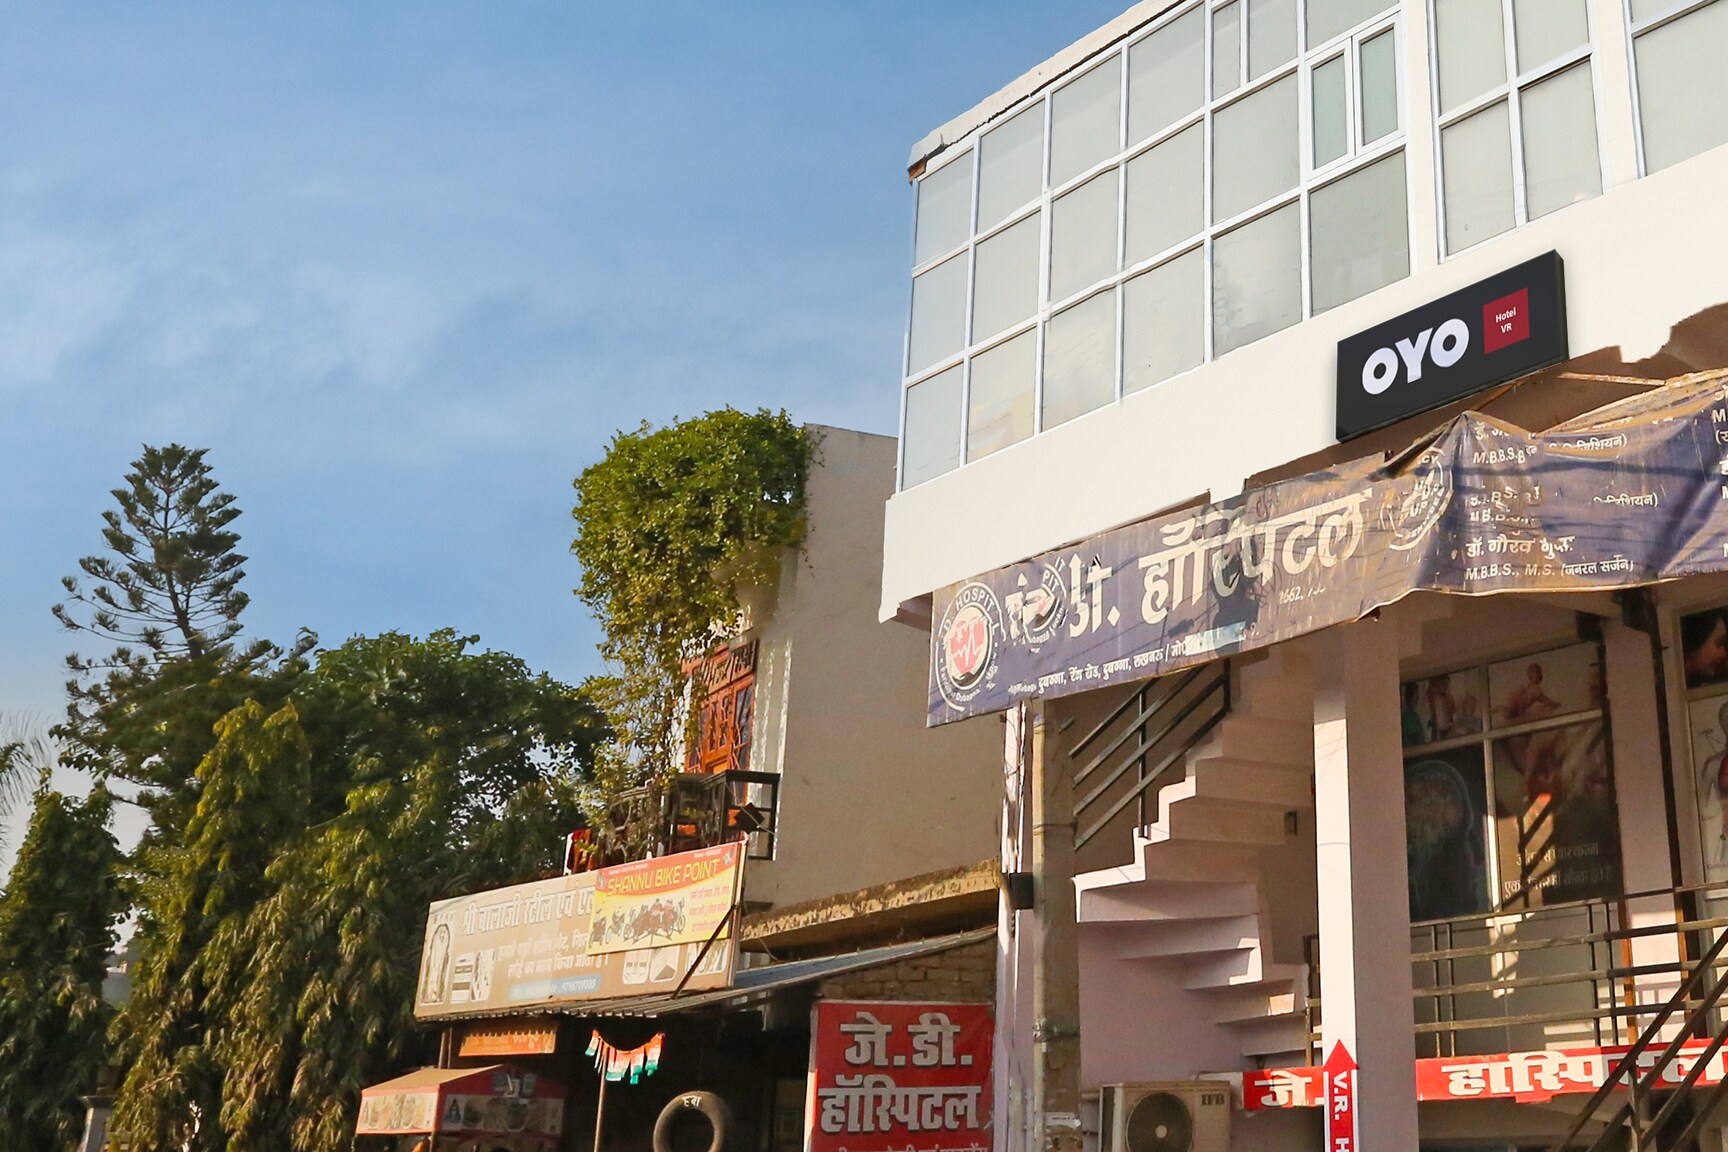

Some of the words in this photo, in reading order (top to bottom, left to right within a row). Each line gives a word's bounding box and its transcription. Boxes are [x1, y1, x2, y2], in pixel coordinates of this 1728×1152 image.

[1495, 307, 1516, 323] Hotel
[1500, 323, 1512, 334] VR
[1362, 318, 1469, 395] OYO
[606, 874, 653, 896] SHANNU
[654, 864, 681, 887] BIKE
[683, 859, 721, 882] POINT
[818, 1074, 982, 1133] हॉस्पिटल
[1333, 1070, 1349, 1121] V.R.
